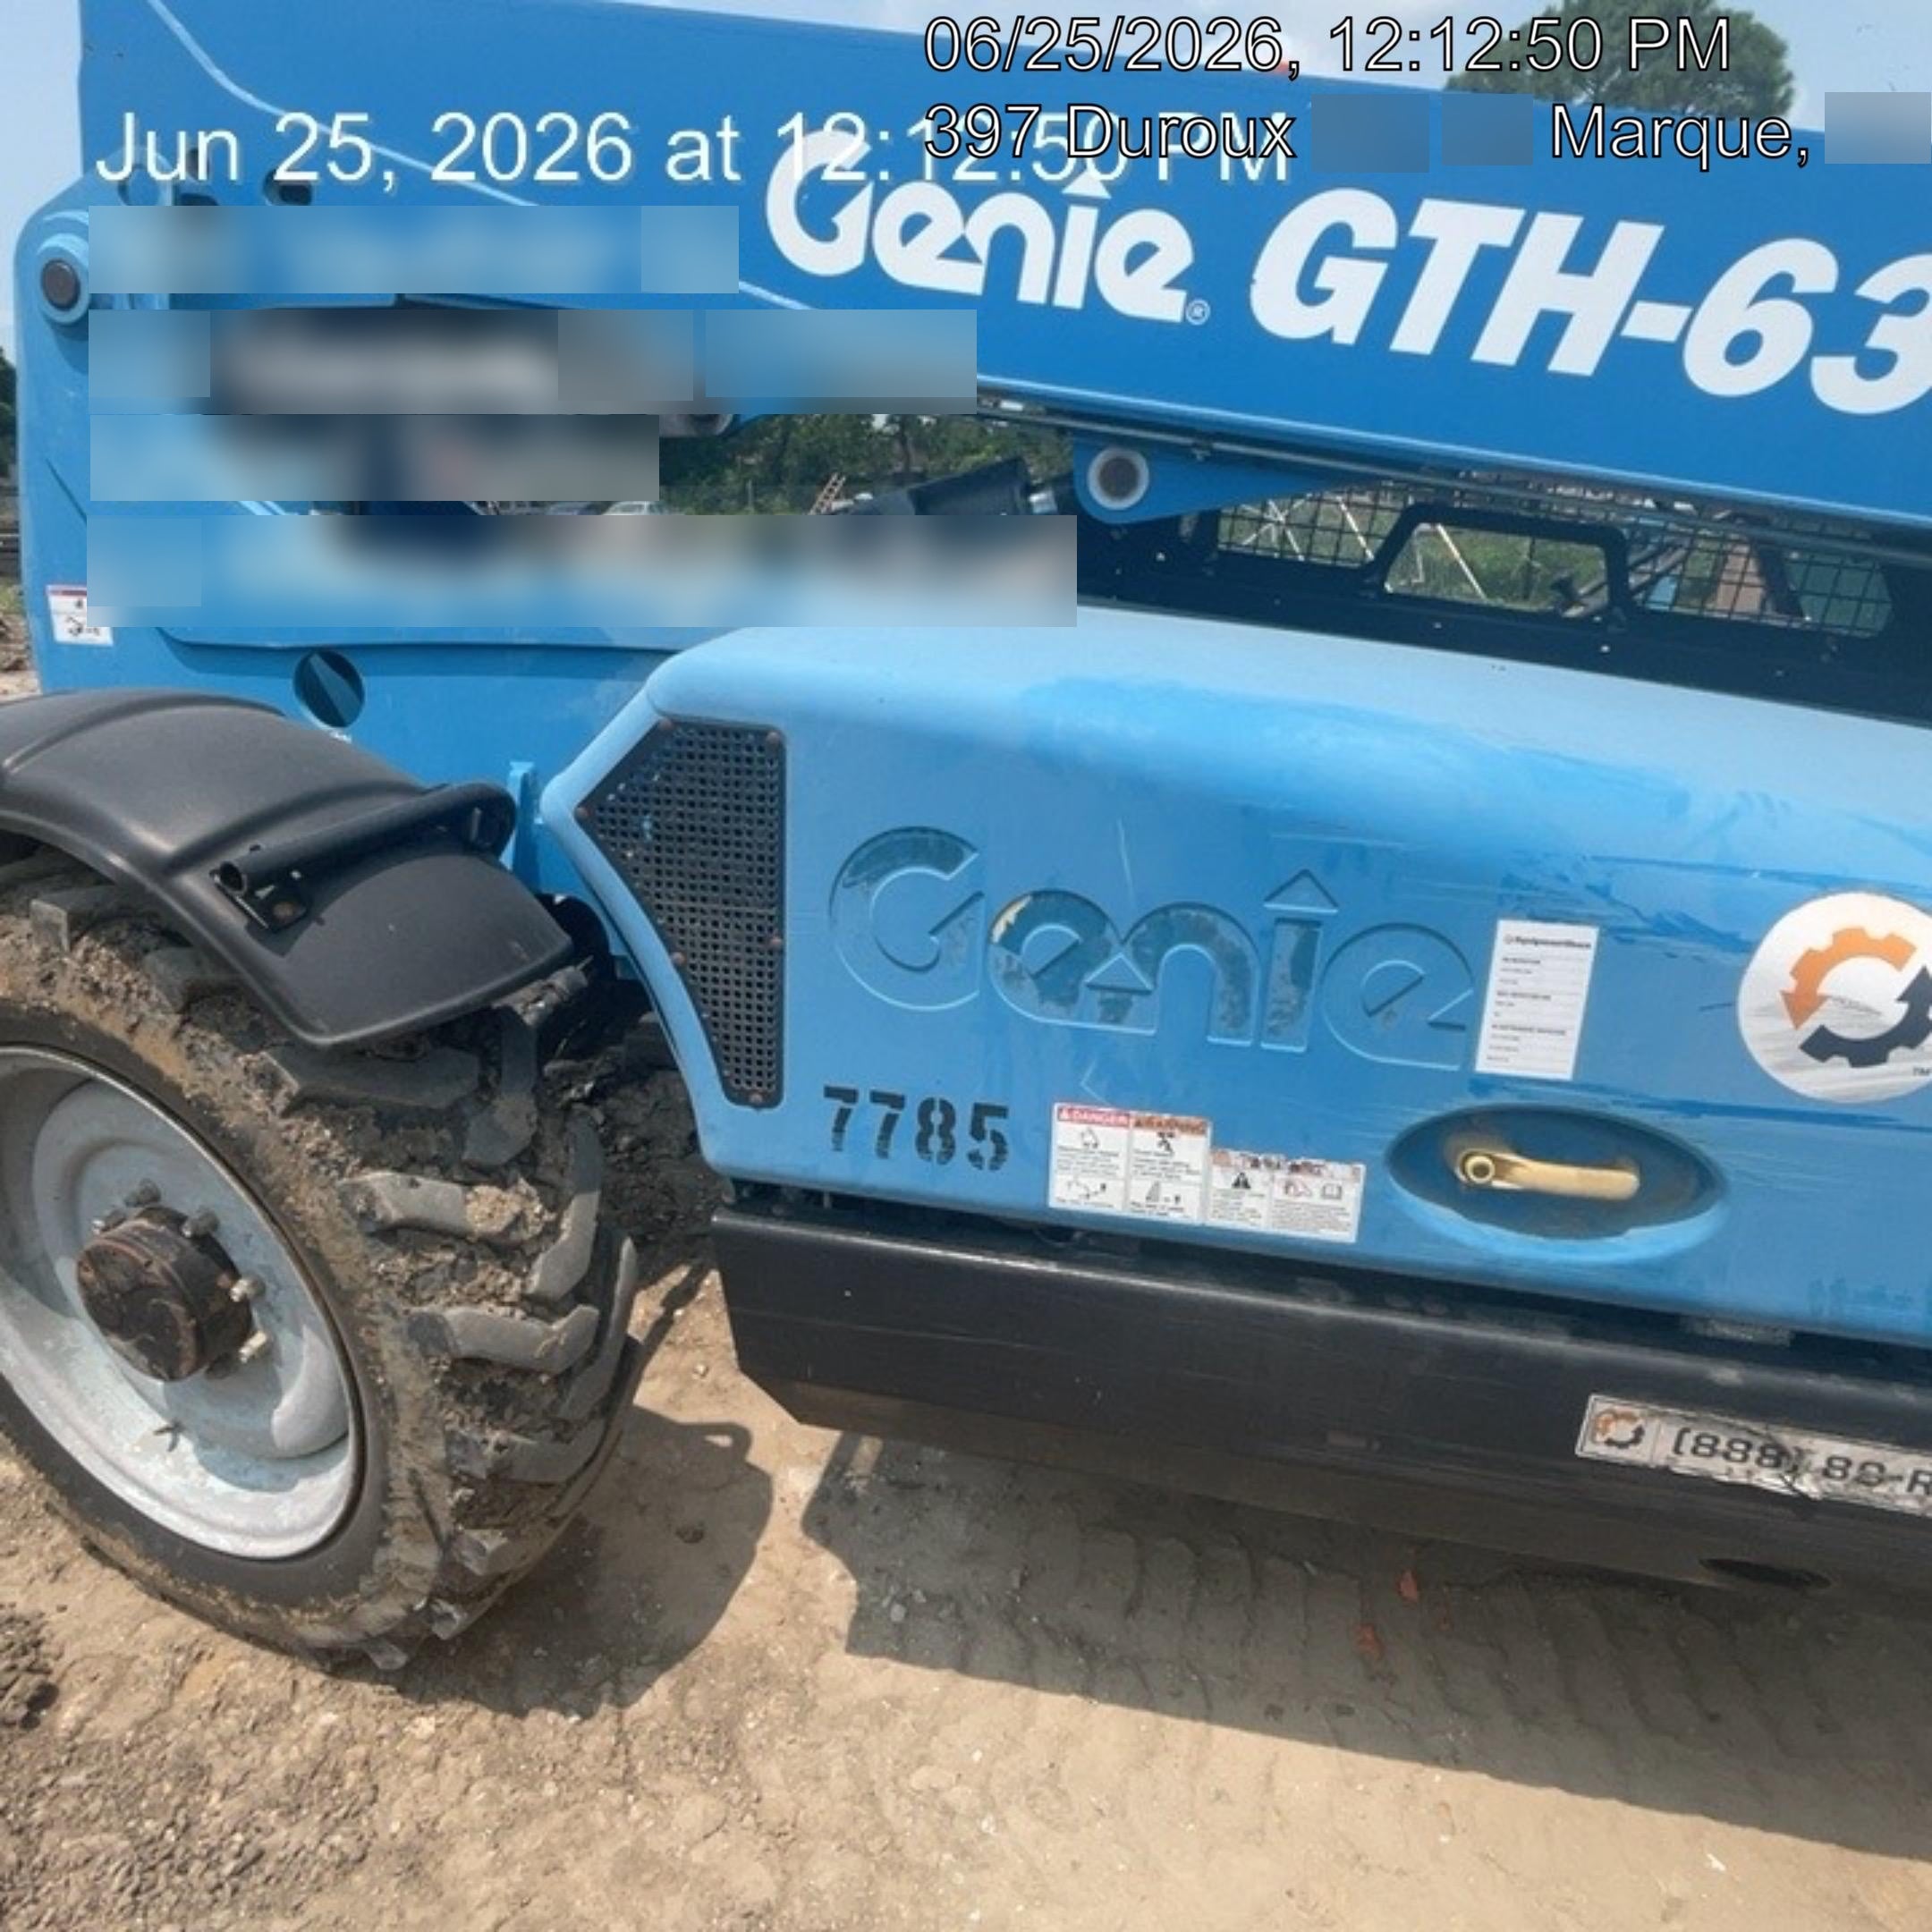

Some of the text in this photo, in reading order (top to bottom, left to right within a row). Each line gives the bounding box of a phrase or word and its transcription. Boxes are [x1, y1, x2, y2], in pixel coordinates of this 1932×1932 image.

[766, 129, 1932, 415] Genie GTH-63
[828, 825, 1476, 1072] Genie
[823, 1084, 1011, 1173] 7785
